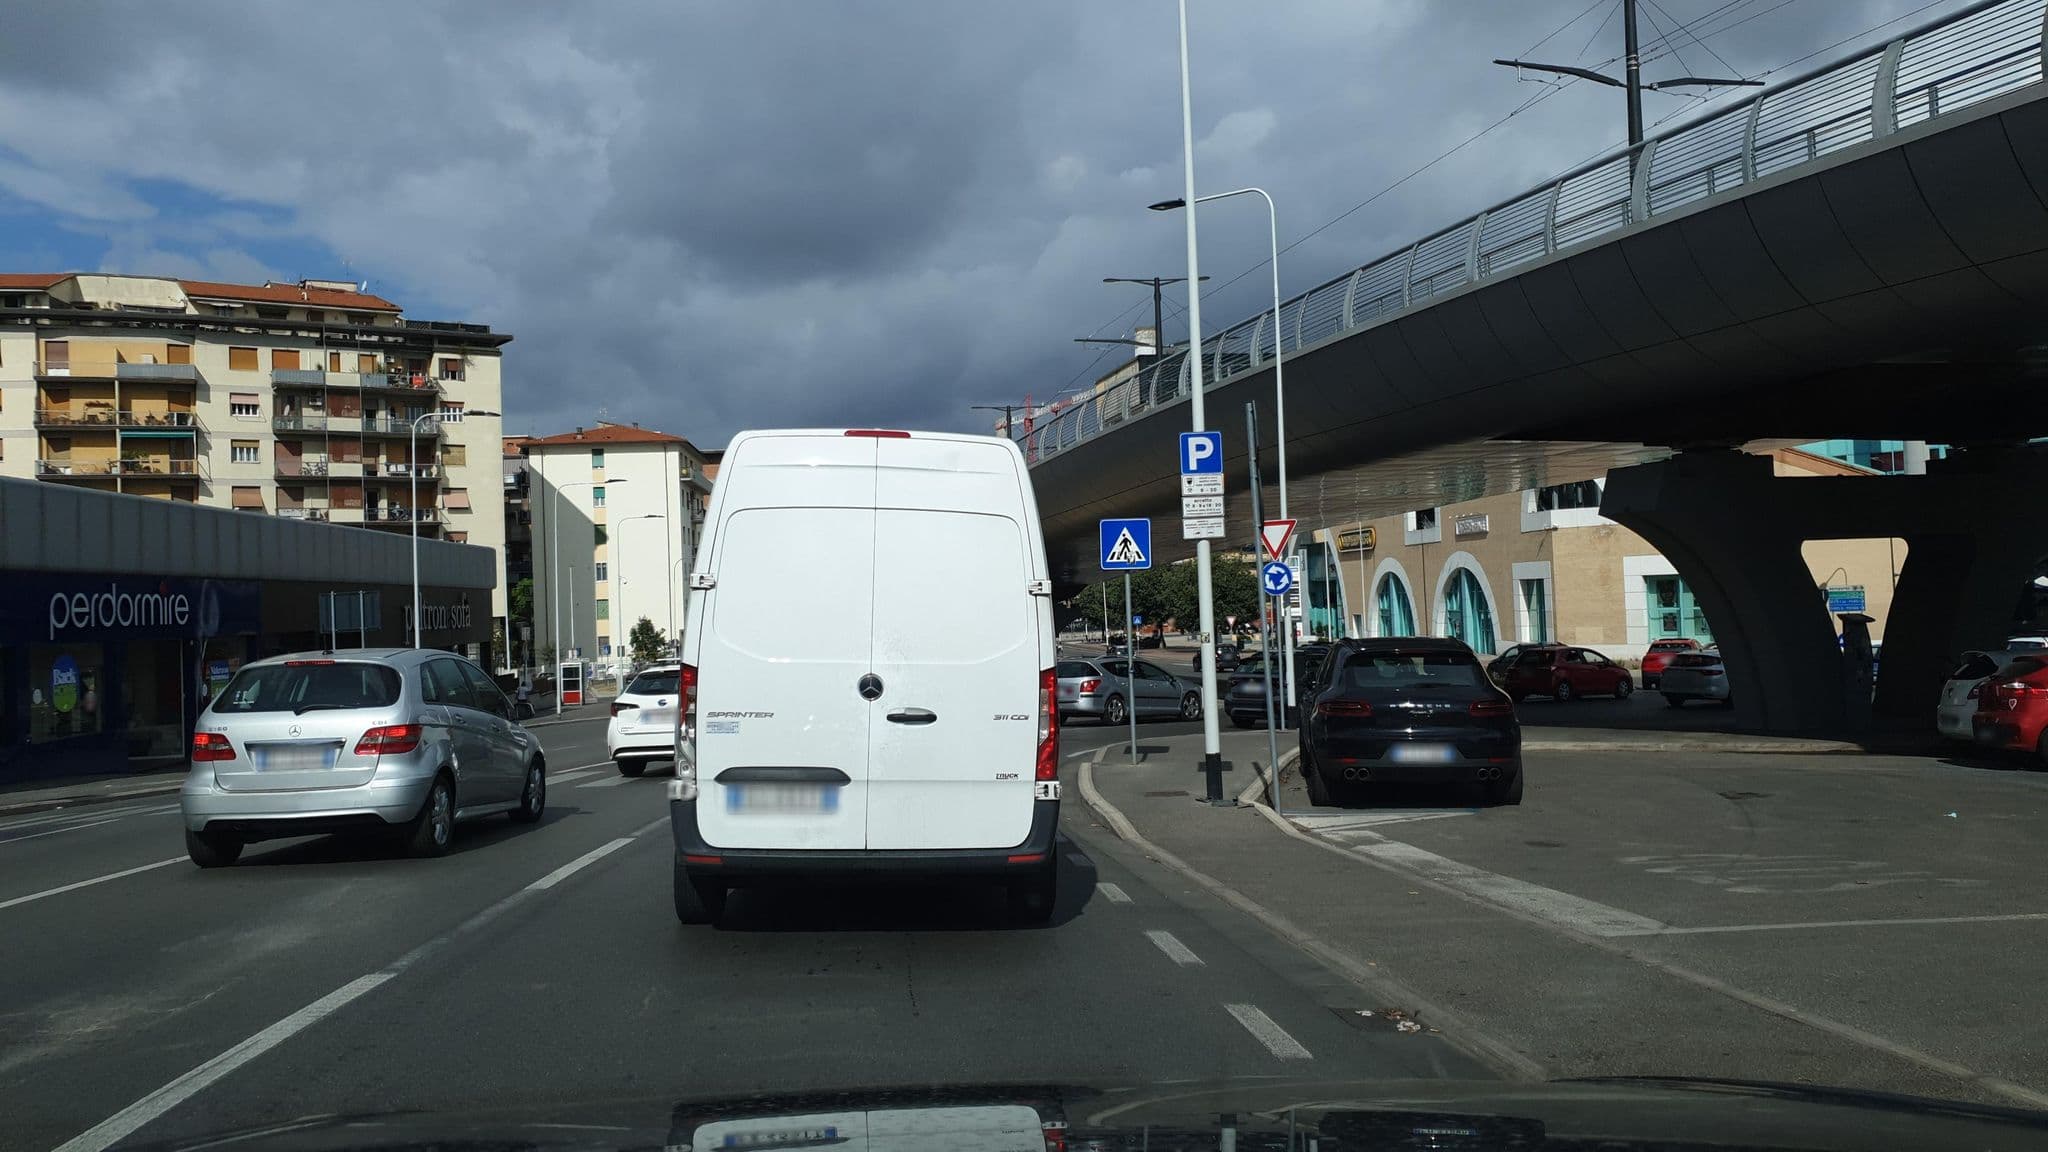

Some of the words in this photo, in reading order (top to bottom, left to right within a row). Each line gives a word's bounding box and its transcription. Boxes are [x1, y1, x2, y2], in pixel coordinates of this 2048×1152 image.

[1188, 437, 1214, 471] P
[50, 581, 189, 641] perdormire
[404, 592, 447, 645] pltron
